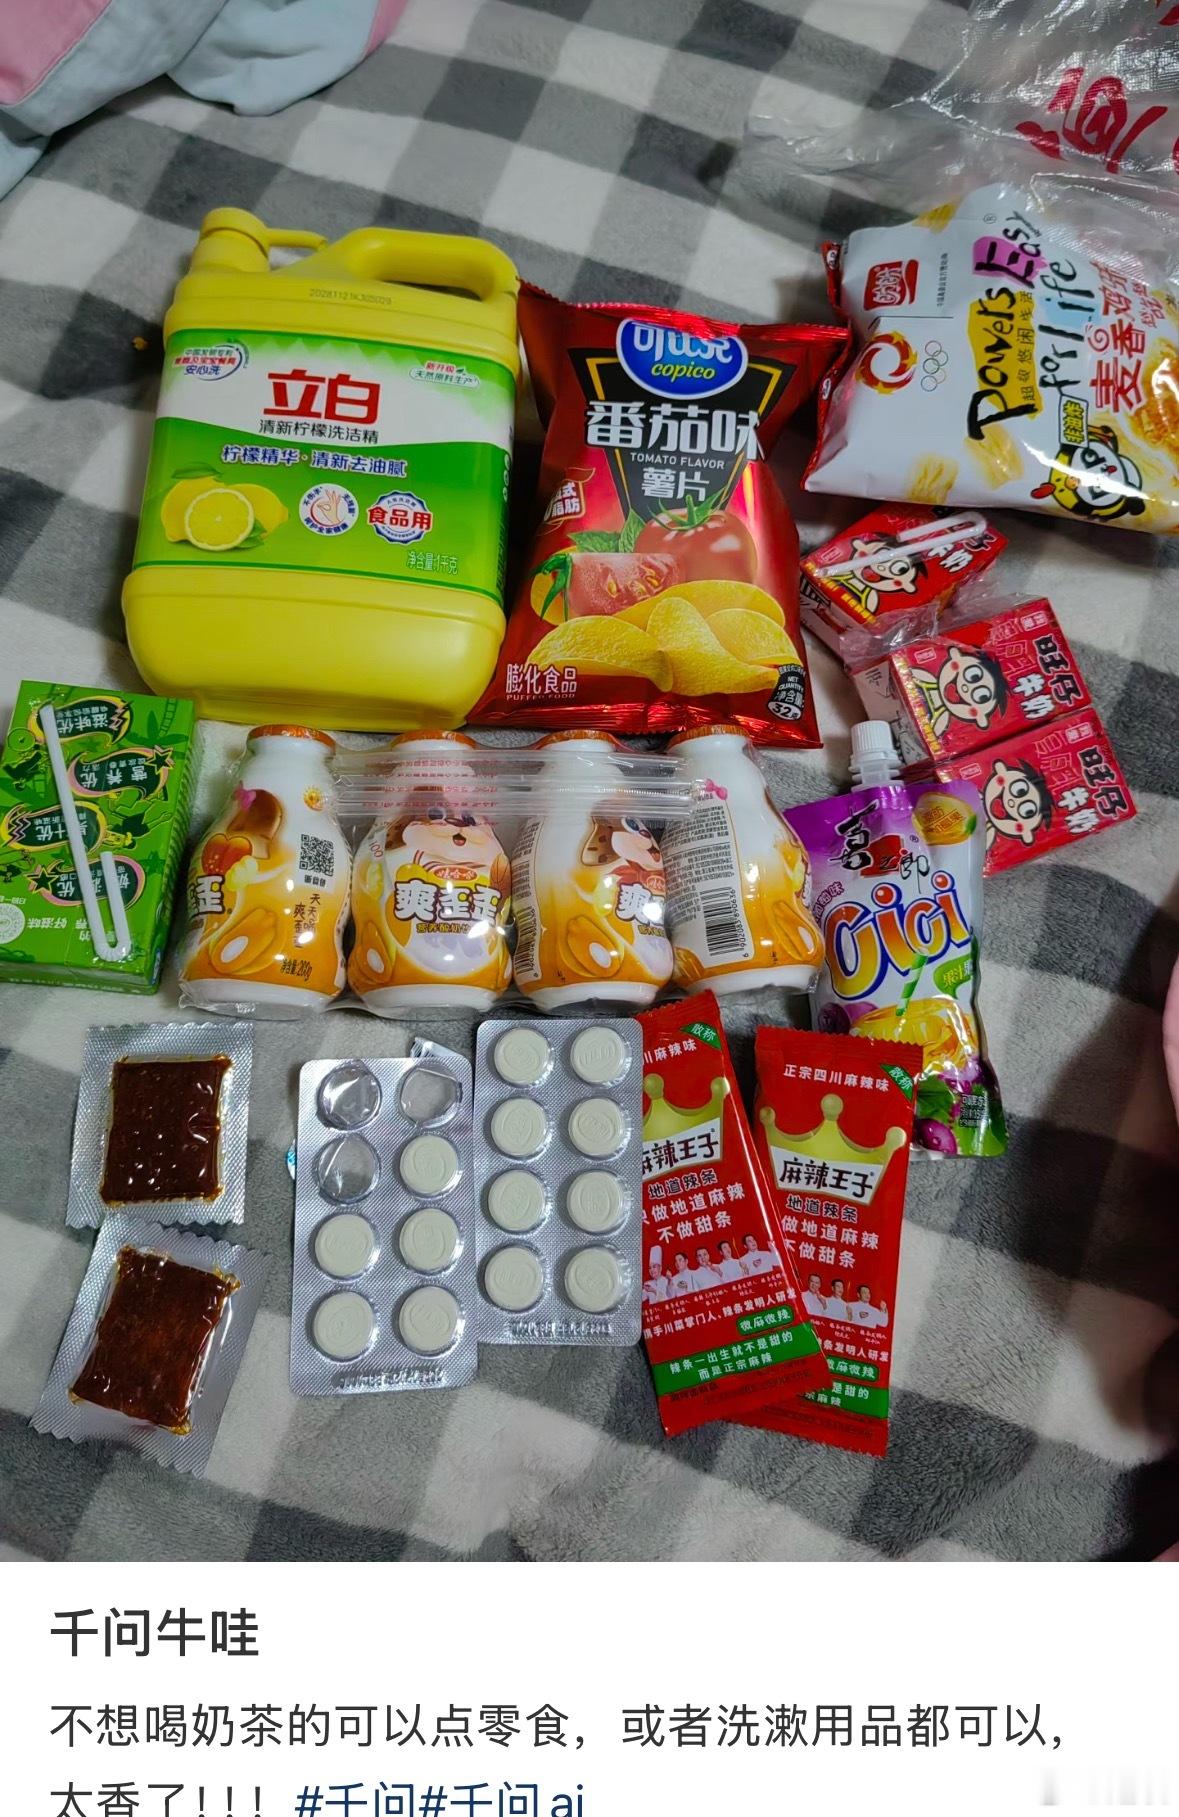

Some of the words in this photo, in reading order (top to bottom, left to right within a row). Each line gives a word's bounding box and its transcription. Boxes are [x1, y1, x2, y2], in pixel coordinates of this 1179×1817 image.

[974, 211, 1042, 289] Easy
[651, 361, 716, 383] copico
[967, 287, 1039, 440] Powers
[1039, 343, 1081, 390] for
[263, 370, 381, 425] 立白
[258, 419, 379, 444] 清新柠檬洗洁精
[586, 400, 765, 461] 番茄味
[1062, 399, 1086, 445] 非油炸
[630, 452, 677, 465] TOMATO
[680, 456, 726, 470] FLAVOR
[641, 467, 710, 502] 薯片
[368, 506, 432, 531] 食品用
[506, 663, 578, 694] 膨化食品
[1034, 634, 1084, 707] 旺仔
[1013, 673, 1056, 720] 牛奶
[1078, 746, 1129, 820] 旺仔
[1057, 786, 1100, 834] 牛奶
[393, 877, 503, 925] 爽歪歪
[825, 869, 972, 1001] Cici
[783, 1064, 890, 1093] 正宗四川麻辣味
[648, 1168, 718, 1199] 地道辣条
[779, 1157, 874, 1199] 麻辣王子
[656, 1211, 732, 1245] 不做甜条
[786, 1194, 859, 1224] 地道辣条
[781, 1215, 880, 1250] 做地道麻辣
[669, 1331, 794, 1375] 辣条一出生就不是甜的
[697, 1352, 773, 1381] 而是正宗麻辣
